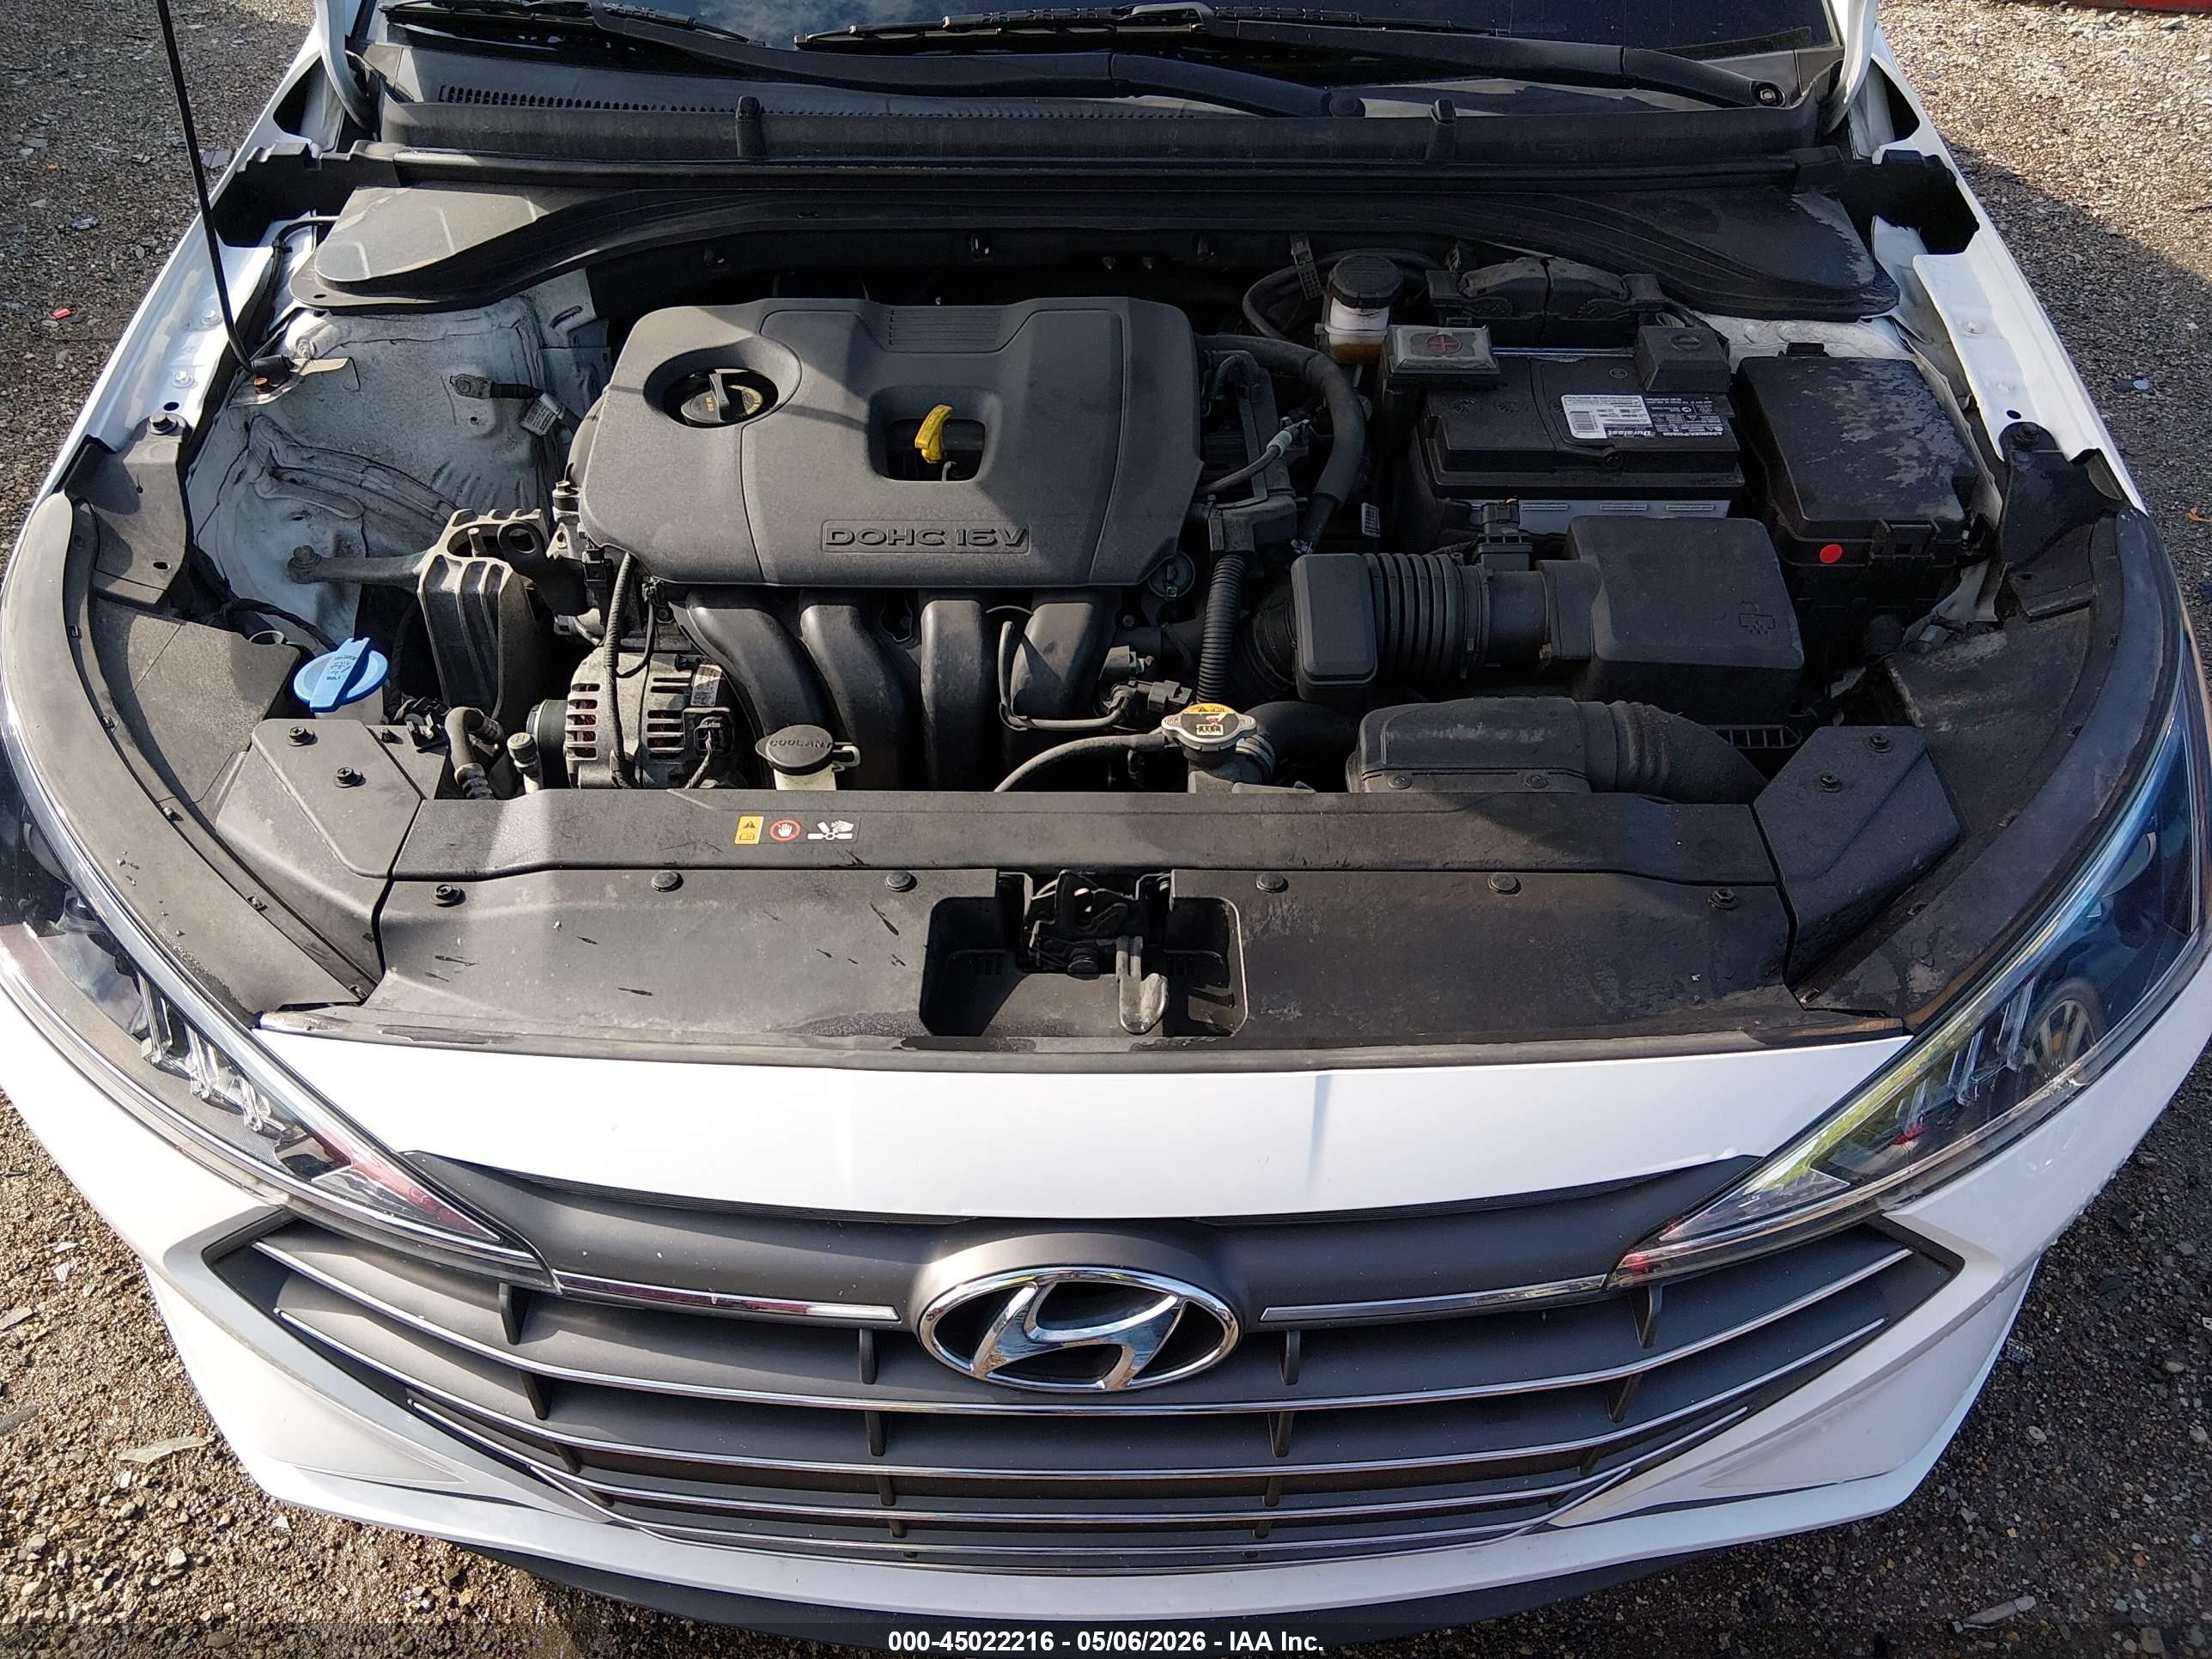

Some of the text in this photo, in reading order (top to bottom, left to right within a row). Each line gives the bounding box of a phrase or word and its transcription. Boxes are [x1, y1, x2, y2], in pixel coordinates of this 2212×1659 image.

[825, 528, 1028, 547] DOHC 16V
[769, 739, 833, 750] COOLANT
